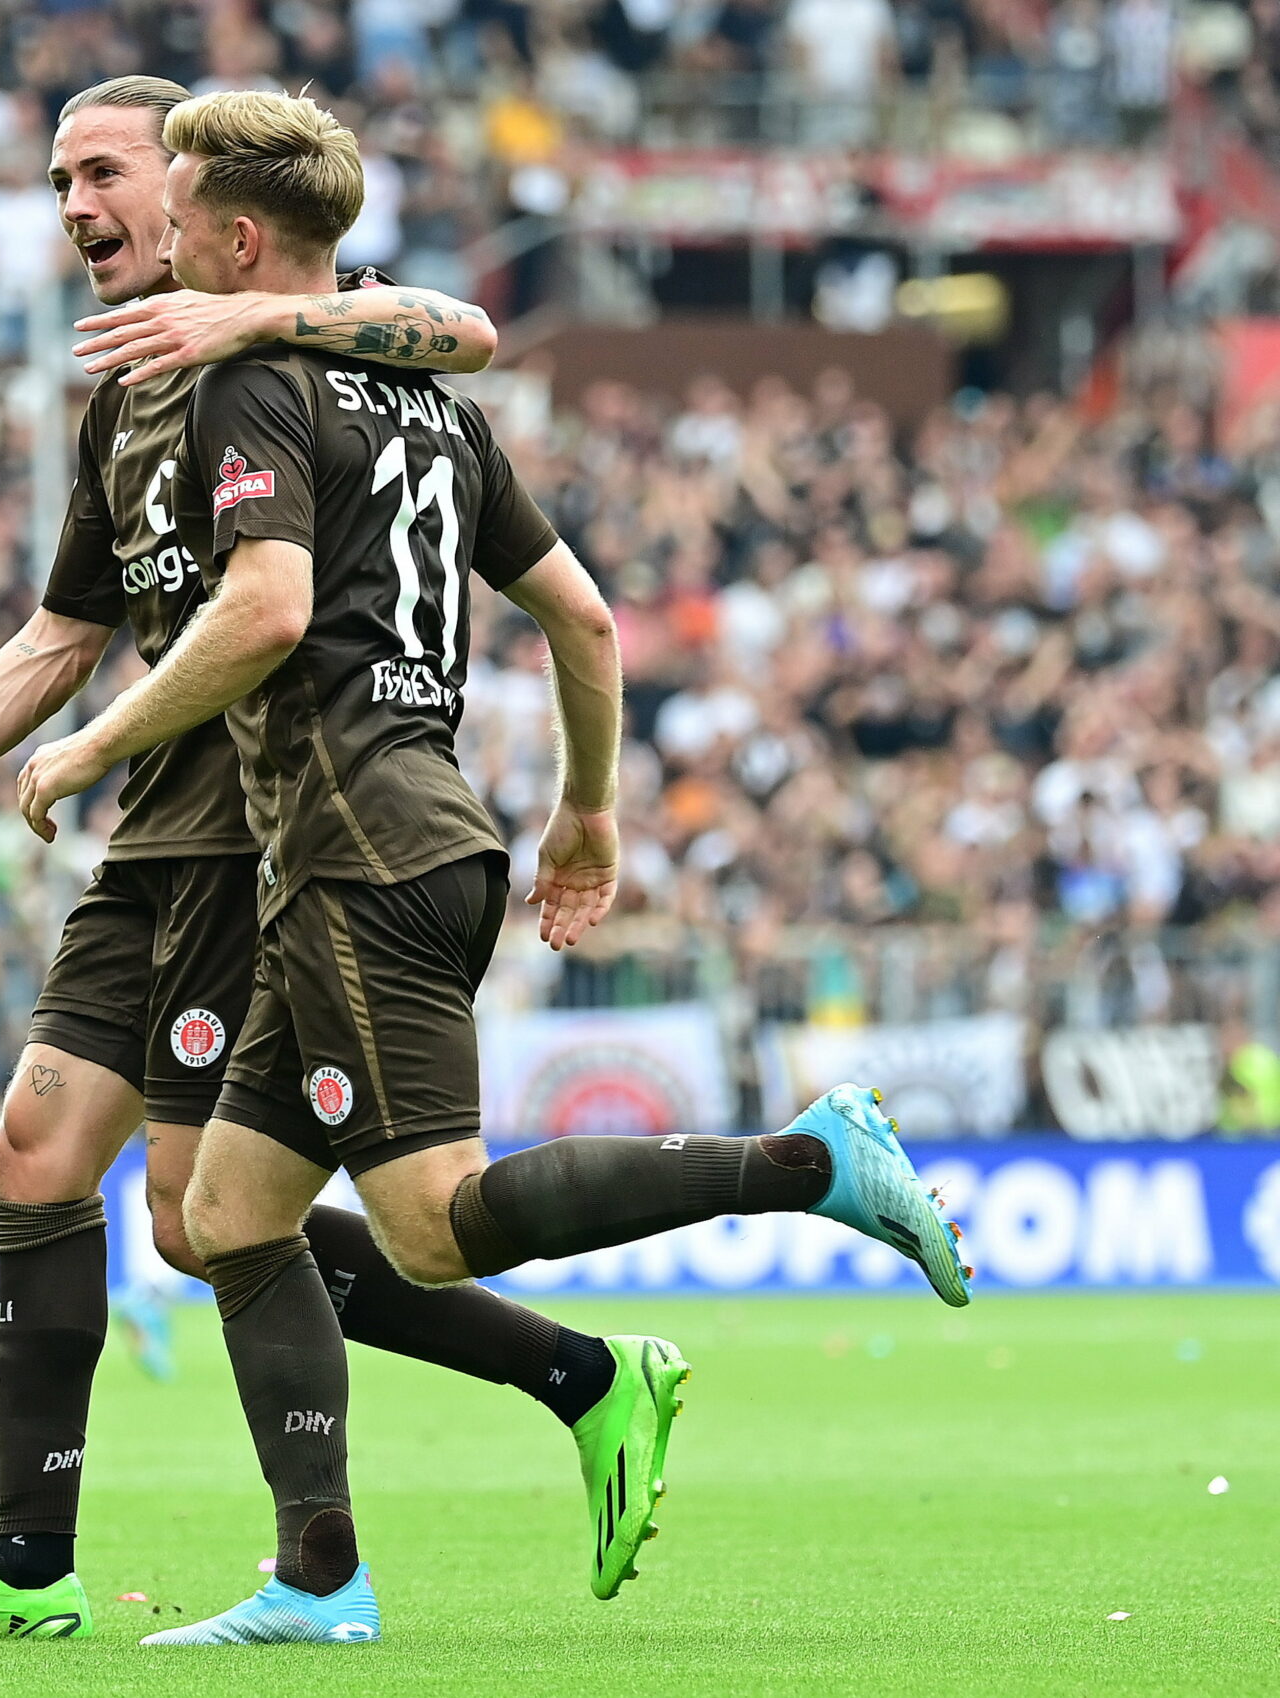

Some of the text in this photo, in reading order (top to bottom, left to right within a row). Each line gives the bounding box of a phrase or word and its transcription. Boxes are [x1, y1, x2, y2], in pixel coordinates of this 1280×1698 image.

[214, 478, 268, 507] ASTRA
[371, 436, 460, 678] 11
[199, 1011, 223, 1038] PAULI
[185, 1056, 207, 1065] 1910
[322, 1069, 348, 1088] PAULI
[328, 1111, 345, 1123] 1910
